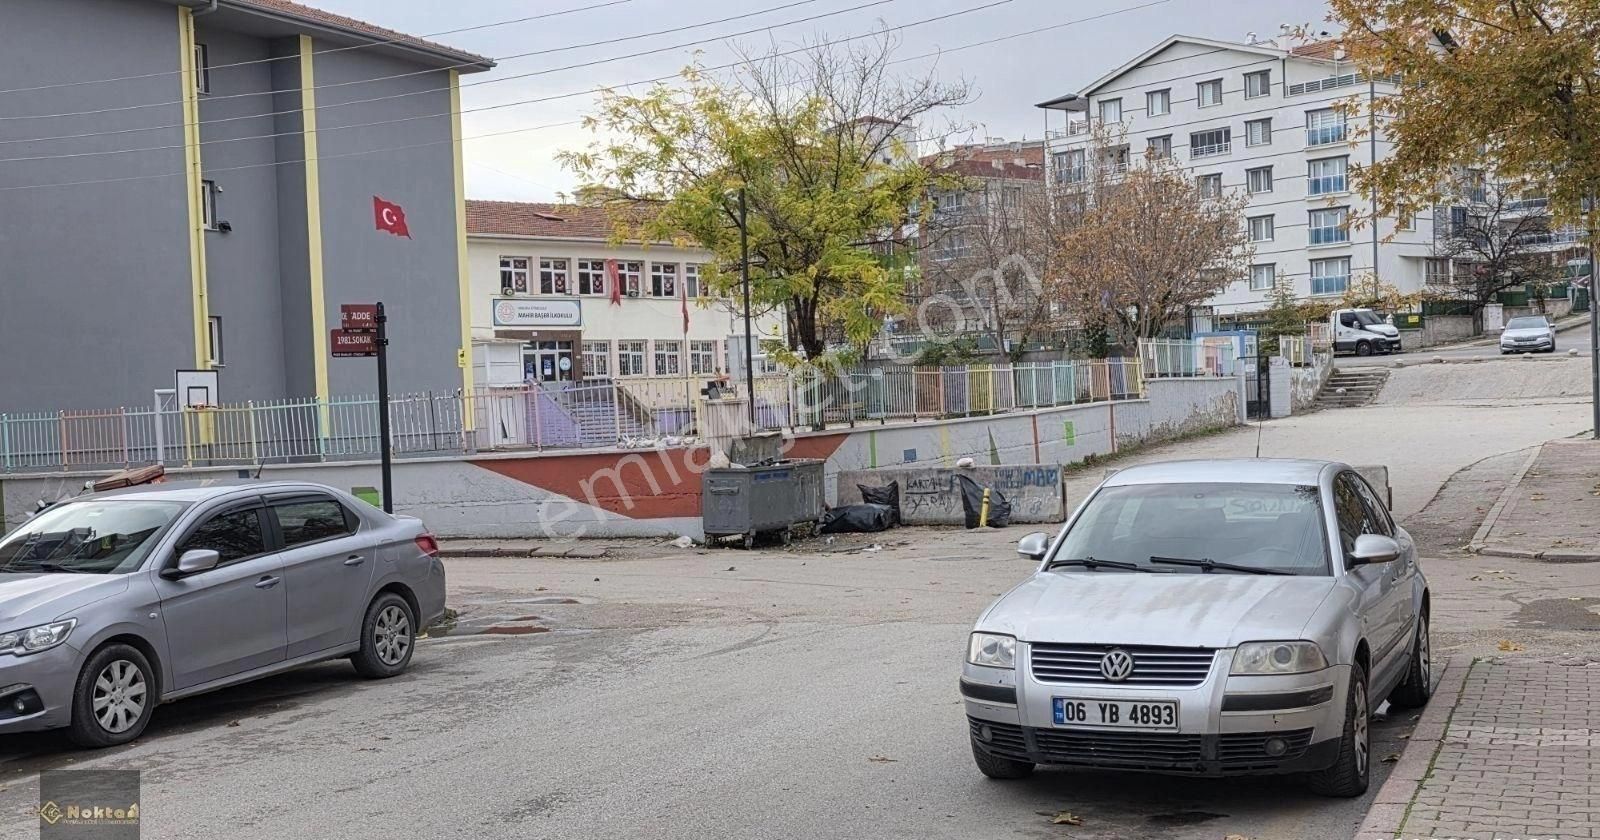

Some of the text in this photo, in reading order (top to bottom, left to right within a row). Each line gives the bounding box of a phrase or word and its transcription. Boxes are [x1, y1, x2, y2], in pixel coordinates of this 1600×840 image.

[1065, 701, 1174, 726] 06 YB 4893
